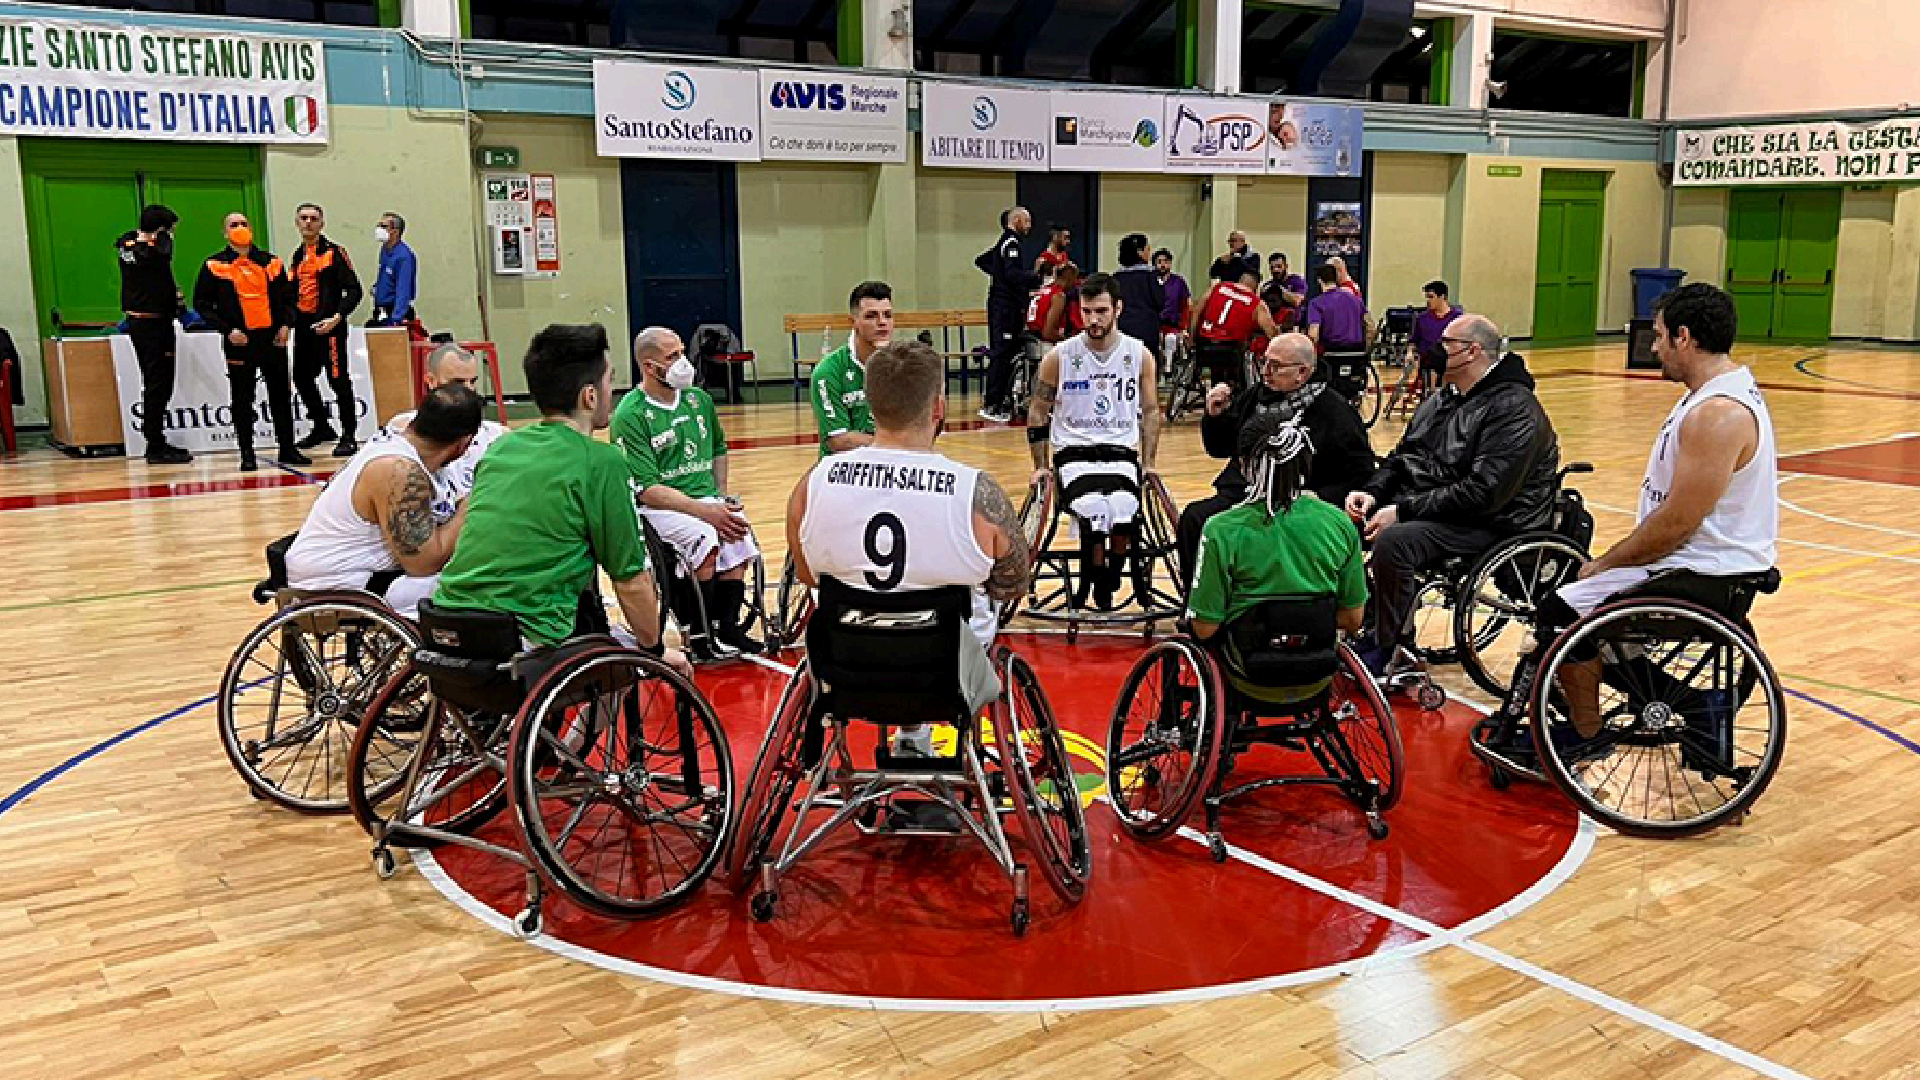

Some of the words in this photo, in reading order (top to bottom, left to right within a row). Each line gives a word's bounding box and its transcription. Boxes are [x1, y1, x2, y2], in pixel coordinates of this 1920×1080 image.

[45, 27, 132, 74] SANTO
[139, 35, 252, 79] STEFANO
[261, 43, 315, 81] AVIS
[0, 83, 149, 131] CAMPIONE
[160, 92, 276, 135] D'ITALIA
[770, 82, 847, 111] AVIS
[851, 101, 888, 113] Marche
[604, 113, 754, 144] SantoStefano
[1218, 122, 1253, 151] PSP
[1713, 132, 1755, 156] CHE
[1761, 131, 1801, 154] SIA
[1808, 129, 1840, 151] LA
[927, 135, 984, 158] ABITARE
[985, 139, 1000, 159] IL
[1001, 139, 1045, 161] TEMPO
[1835, 152, 1881, 178] NON
[1113, 377, 1137, 402] 16
[827, 461, 957, 496] GRIFFITH-SALTER
[862, 511, 908, 592] 9
